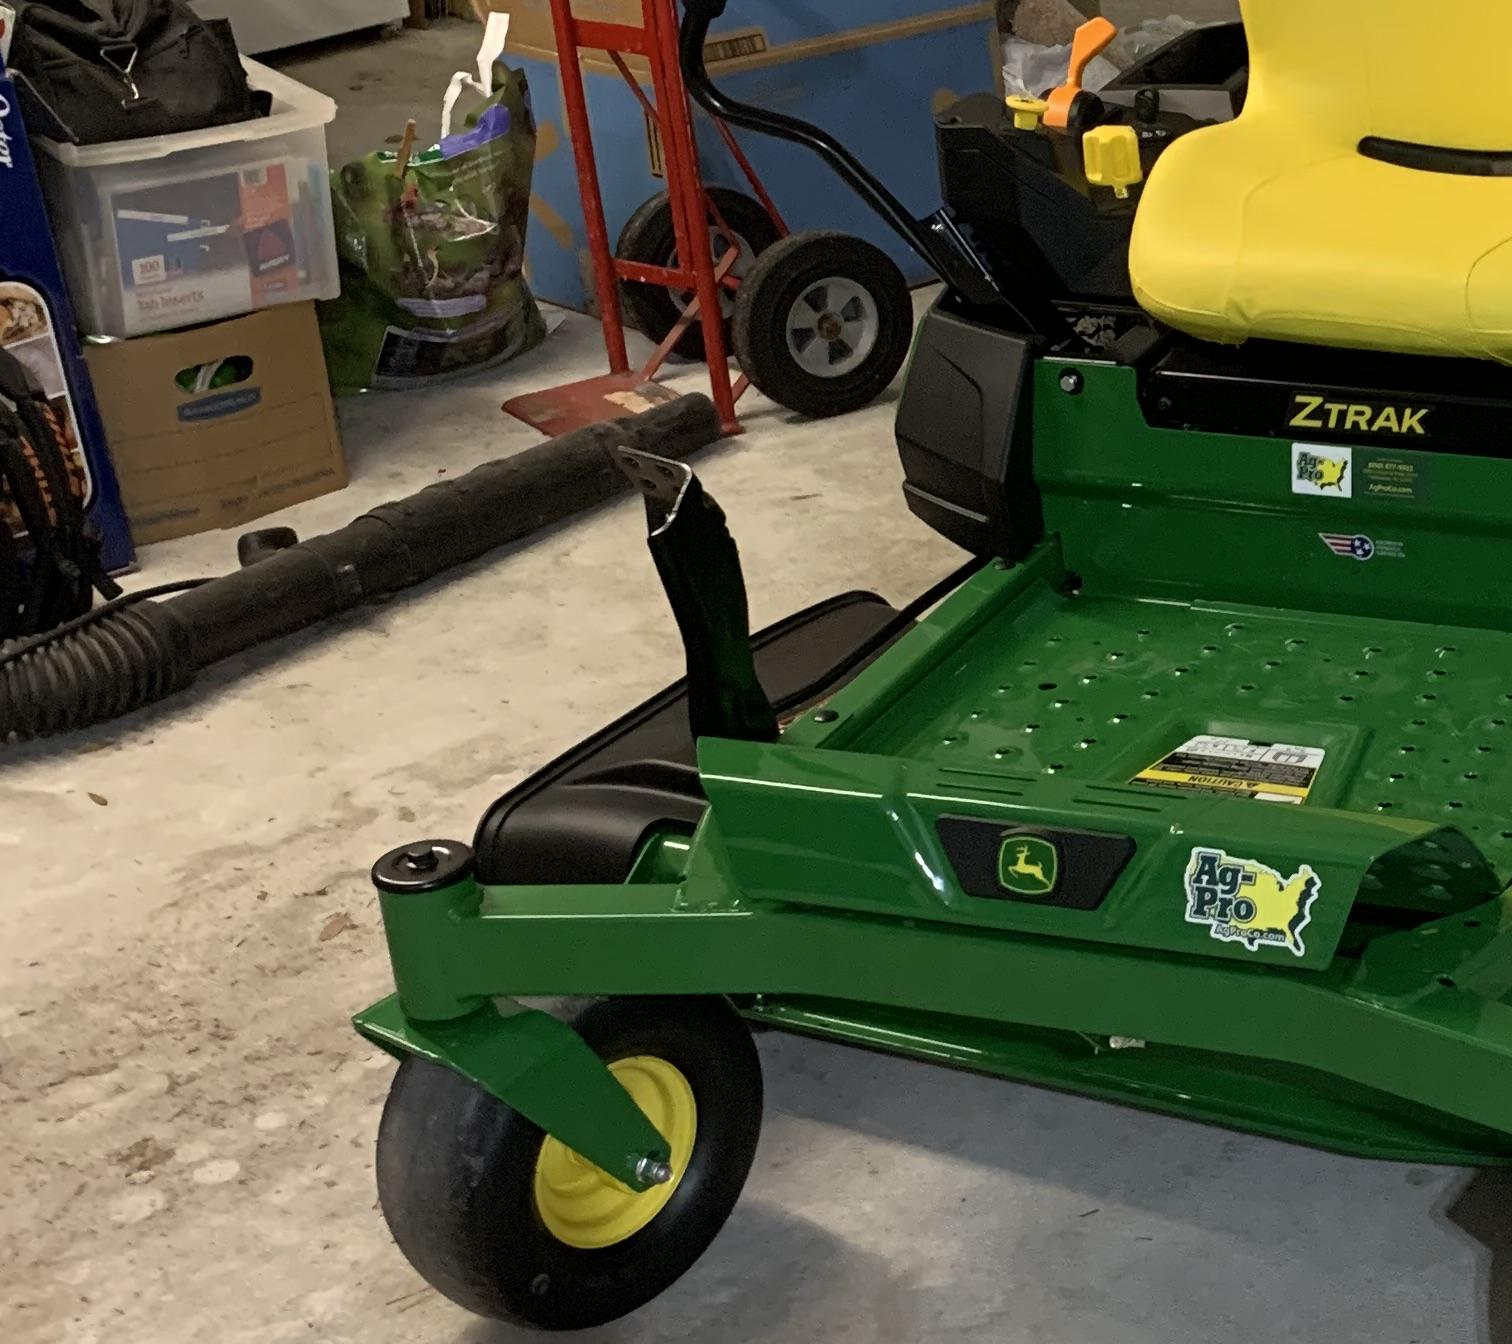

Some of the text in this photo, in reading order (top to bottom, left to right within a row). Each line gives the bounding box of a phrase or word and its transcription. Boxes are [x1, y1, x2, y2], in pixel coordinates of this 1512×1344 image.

[1188, 775, 1243, 789] CAUTION
[1190, 886, 1256, 923] Pro
[1214, 924, 1286, 942] AgProCo.com
